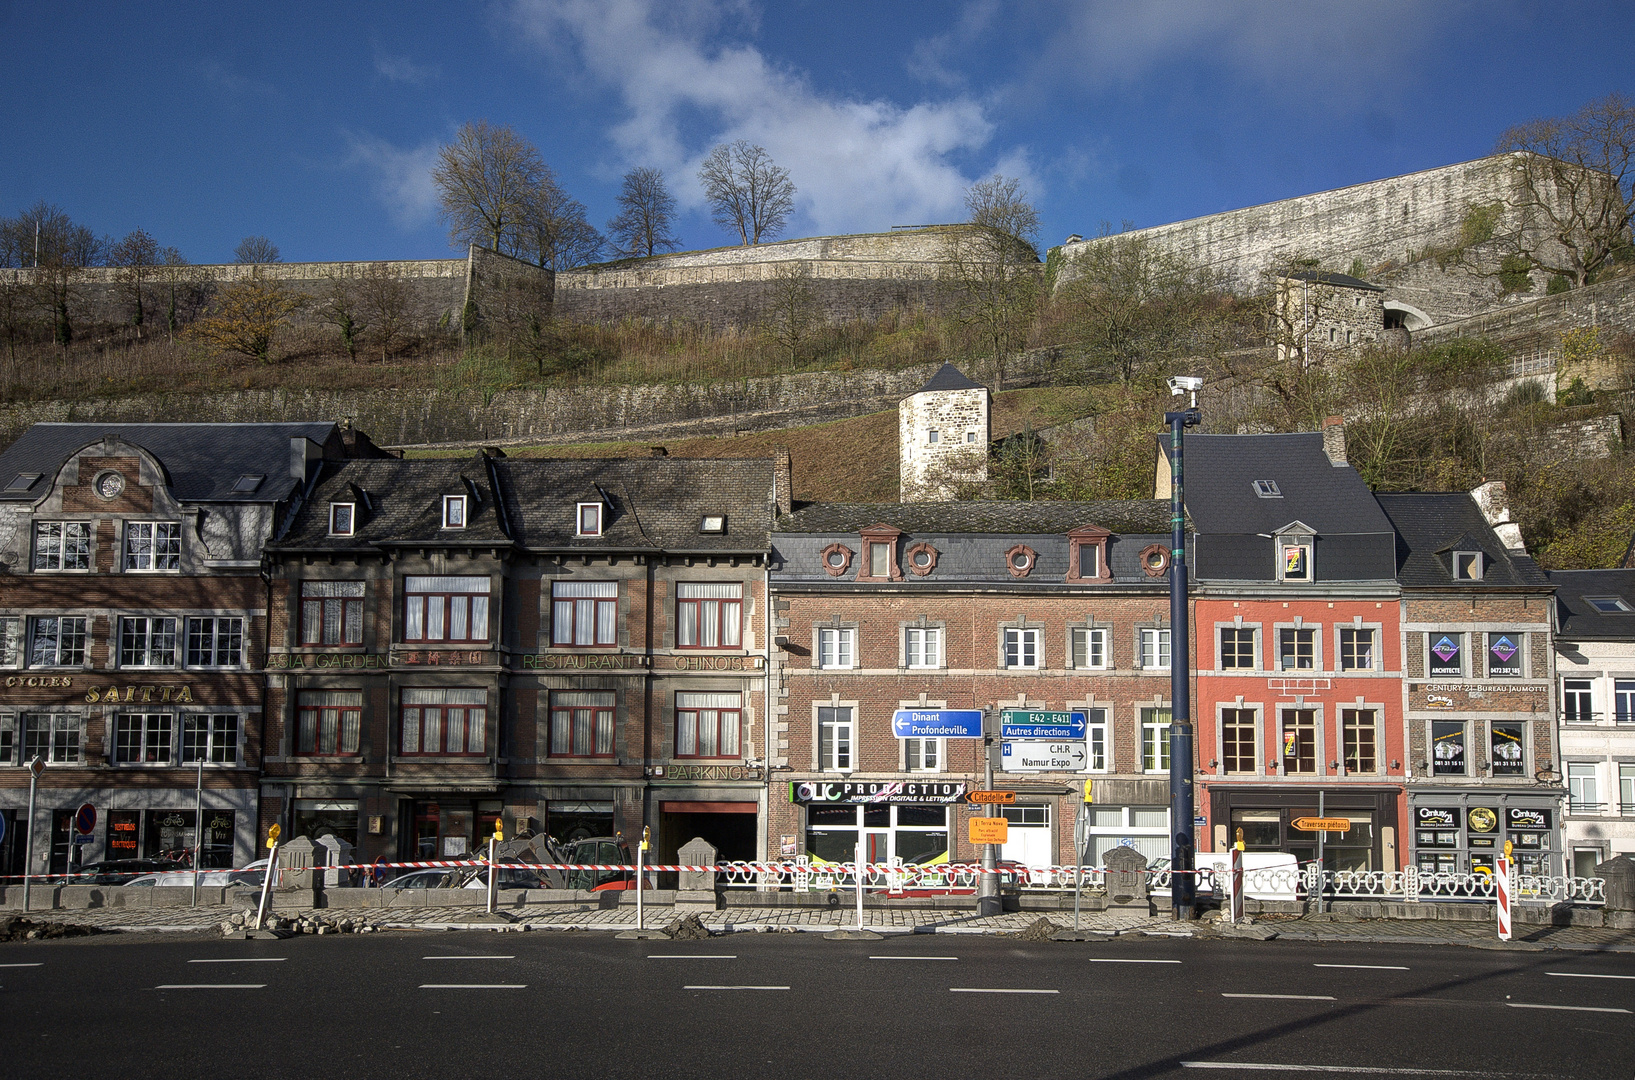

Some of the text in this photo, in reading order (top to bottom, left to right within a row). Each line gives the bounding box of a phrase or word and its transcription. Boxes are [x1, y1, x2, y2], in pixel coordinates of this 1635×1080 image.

[266, 653, 389, 669] ASIA GARDEN
[523, 655, 634, 670] RESTAURANT
[674, 656, 743, 671] CHINOIS
[5, 676, 73, 688] CYCLES
[85, 685, 194, 703] SAITTA
[1426, 684, 1462, 692] CENTURY
[1477, 685, 1507, 693] BUREAU
[1508, 685, 1547, 694] JAUMOTTE
[912, 713, 940, 722] Dinant
[1029, 714, 1045, 723] E42
[1052, 714, 1070, 723] E411
[912, 725, 968, 735] Profondeville
[1006, 726, 1071, 737] Autres directions
[1004, 744, 1011, 755] H
[1050, 745, 1070, 754] C.H.R
[1022, 758, 1071, 769] Namur Expo
[668, 765, 742, 781] PARKING
[844, 782, 966, 796] PRODUCTION
[889, 795, 916, 803] DIGITALE
[918, 795, 925, 803] &
[974, 792, 1005, 802] Citadelle
[1419, 807, 1454, 824] Century 21
[1511, 808, 1545, 825] Century 21
[1301, 820, 1347, 830] Traversez piétons
